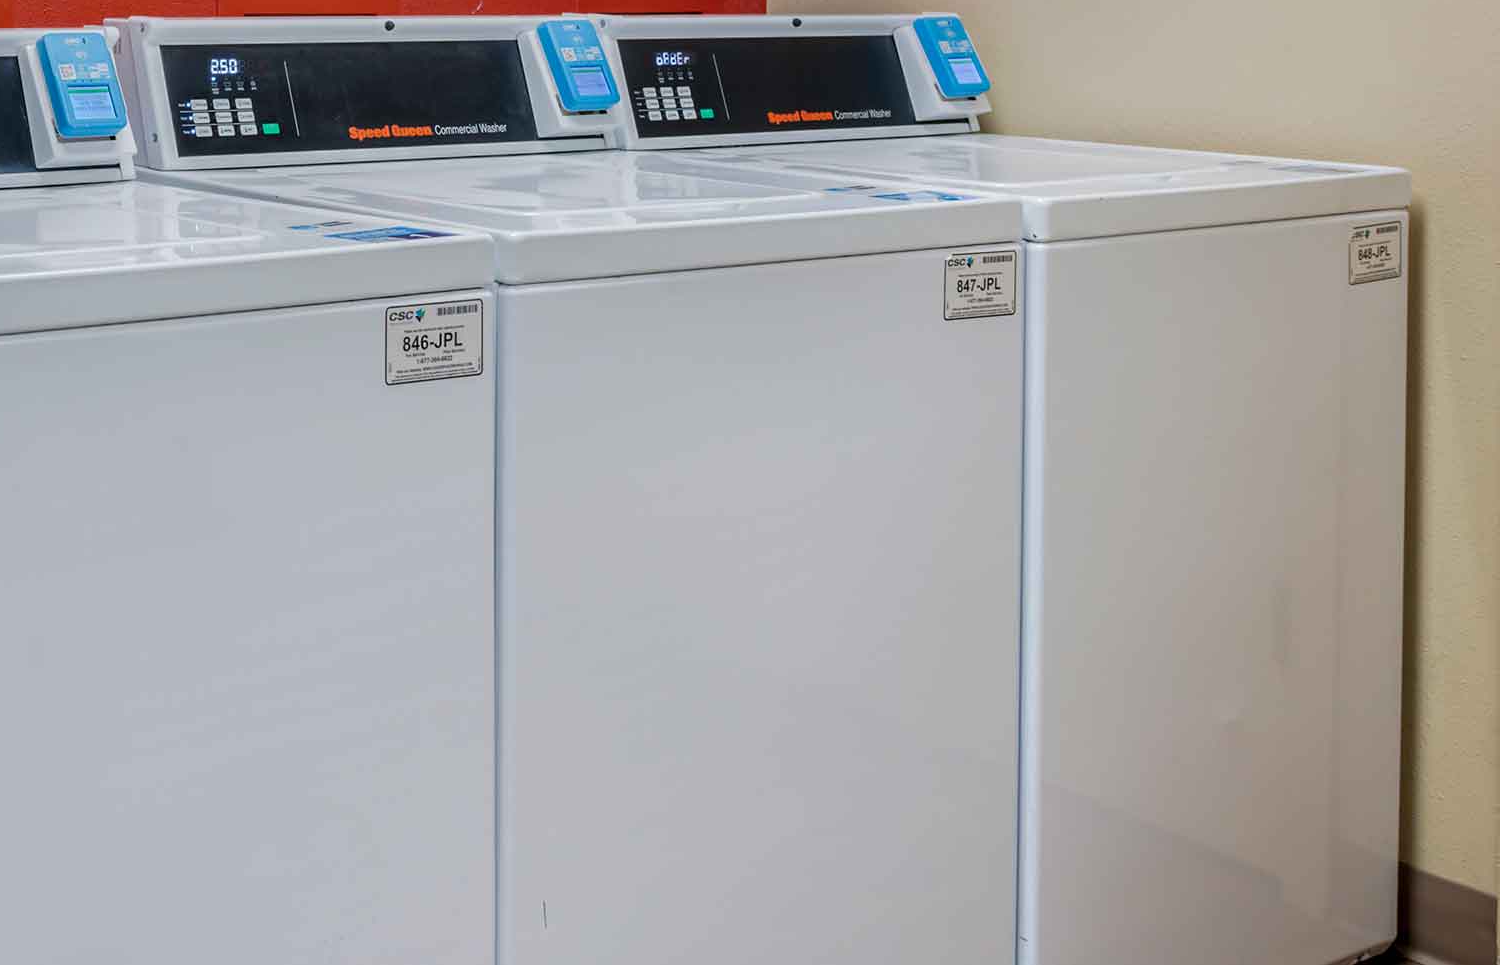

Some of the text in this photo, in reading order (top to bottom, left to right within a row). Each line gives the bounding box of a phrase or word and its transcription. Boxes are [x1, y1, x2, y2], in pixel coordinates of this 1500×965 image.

[210, 58, 238, 75] 2.50
[348, 121, 507, 142] Speed Queen Commercial Washer
[947, 258, 966, 267] CSC
[956, 277, 1002, 293] 847-JPL
[388, 310, 414, 322] CSC
[402, 331, 463, 352] 846-JPL
